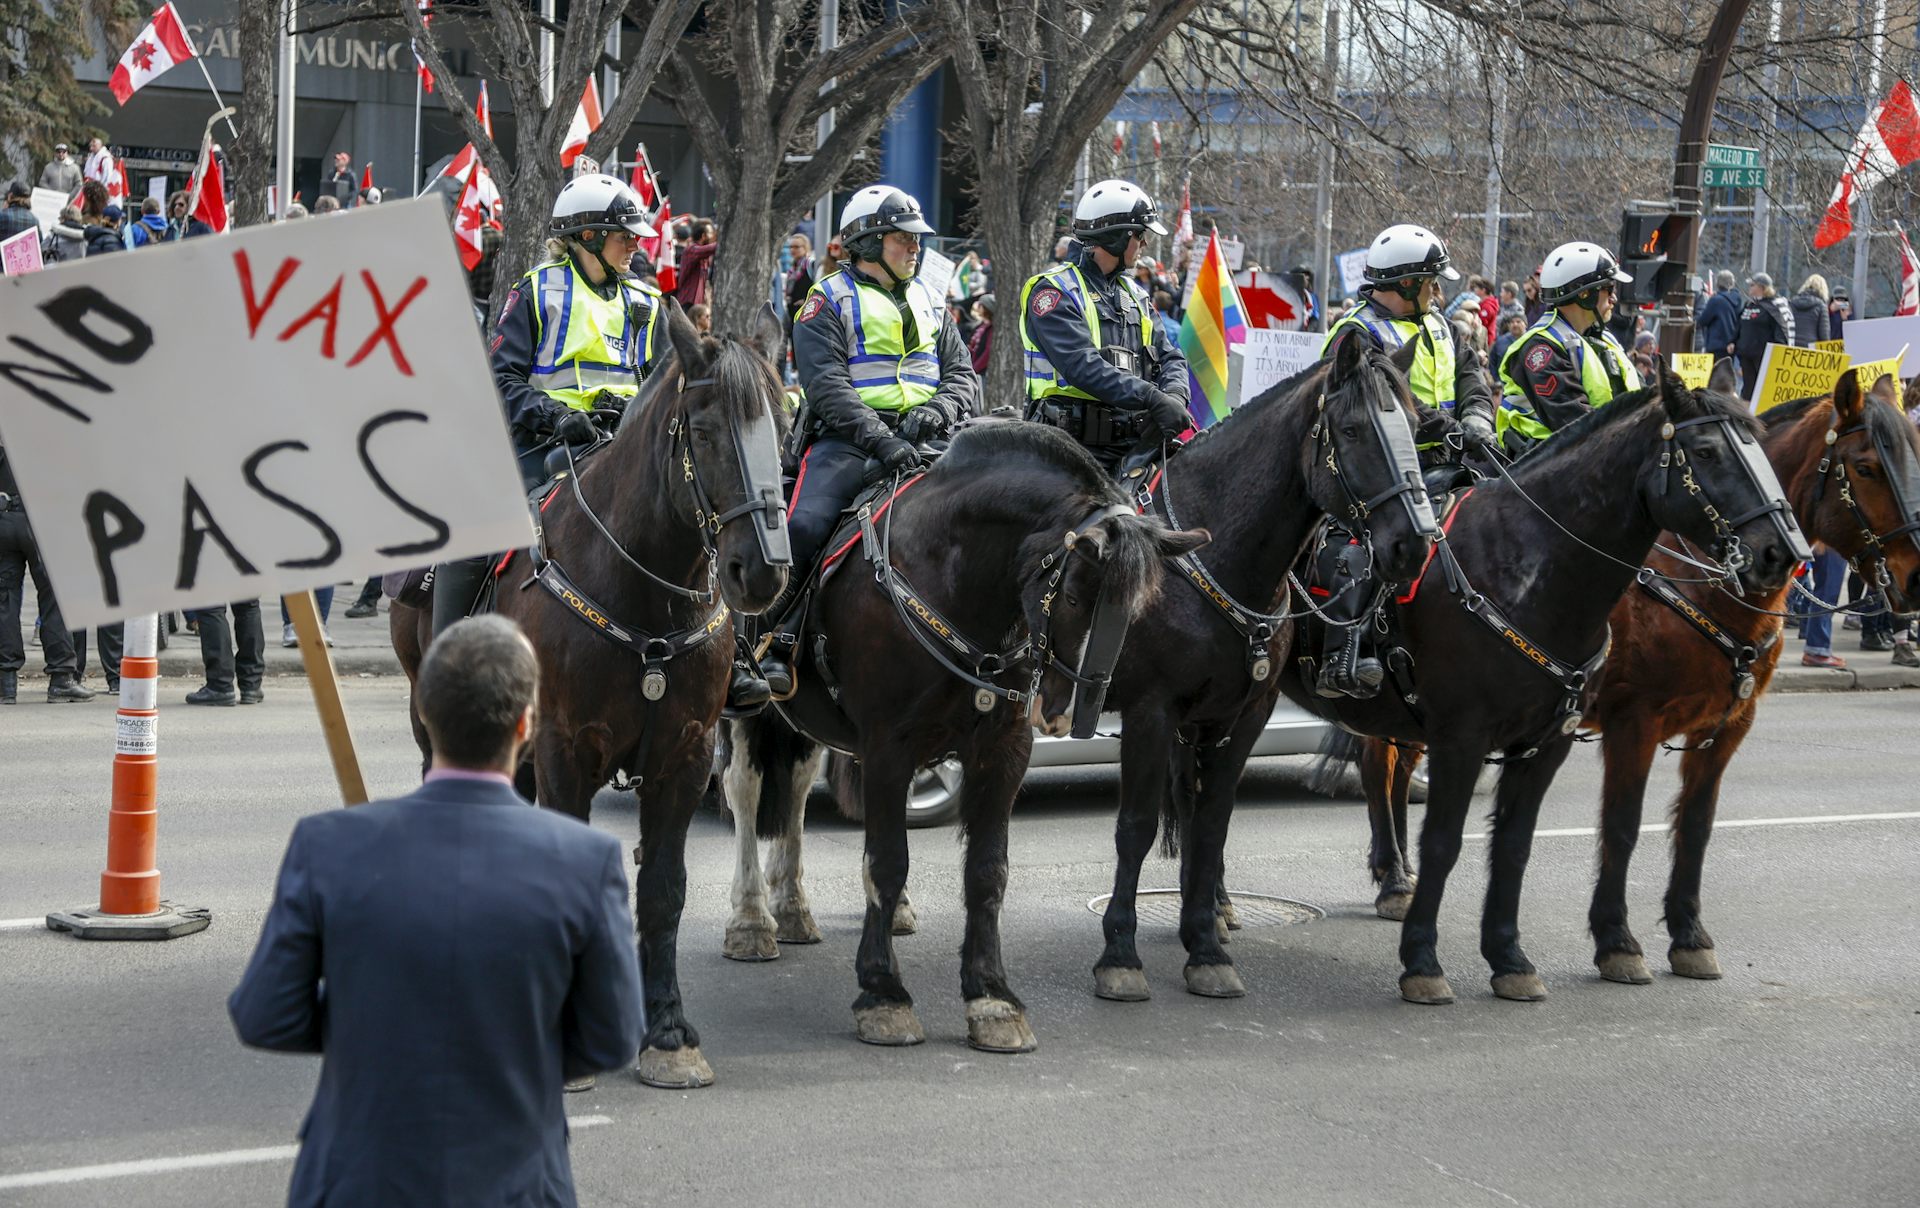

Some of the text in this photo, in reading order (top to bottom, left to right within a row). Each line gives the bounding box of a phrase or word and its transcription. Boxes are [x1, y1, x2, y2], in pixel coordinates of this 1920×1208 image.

[134, 148, 193, 162] MACLEOD
[1709, 148, 1755, 167] MACLEOD TR
[1704, 169, 1761, 185] 8 AVE SE
[232, 248, 428, 377] VAX
[0, 285, 154, 424] NO
[604, 335, 625, 351] LICE
[1262, 345, 1301, 359] A VIRUS
[1289, 335, 1312, 347] ABOUT
[1782, 347, 1842, 372] FREEDOM
[1774, 368, 1832, 390] TO CROSS
[82, 409, 450, 607] PASS
[419, 563, 437, 592] ICE
[1190, 570, 1232, 610] POLICE
[562, 589, 609, 629] POLICE
[907, 597, 951, 638] POLICE
[1676, 599, 1719, 635] POLICE
[1504, 629, 1549, 667] POLICE
